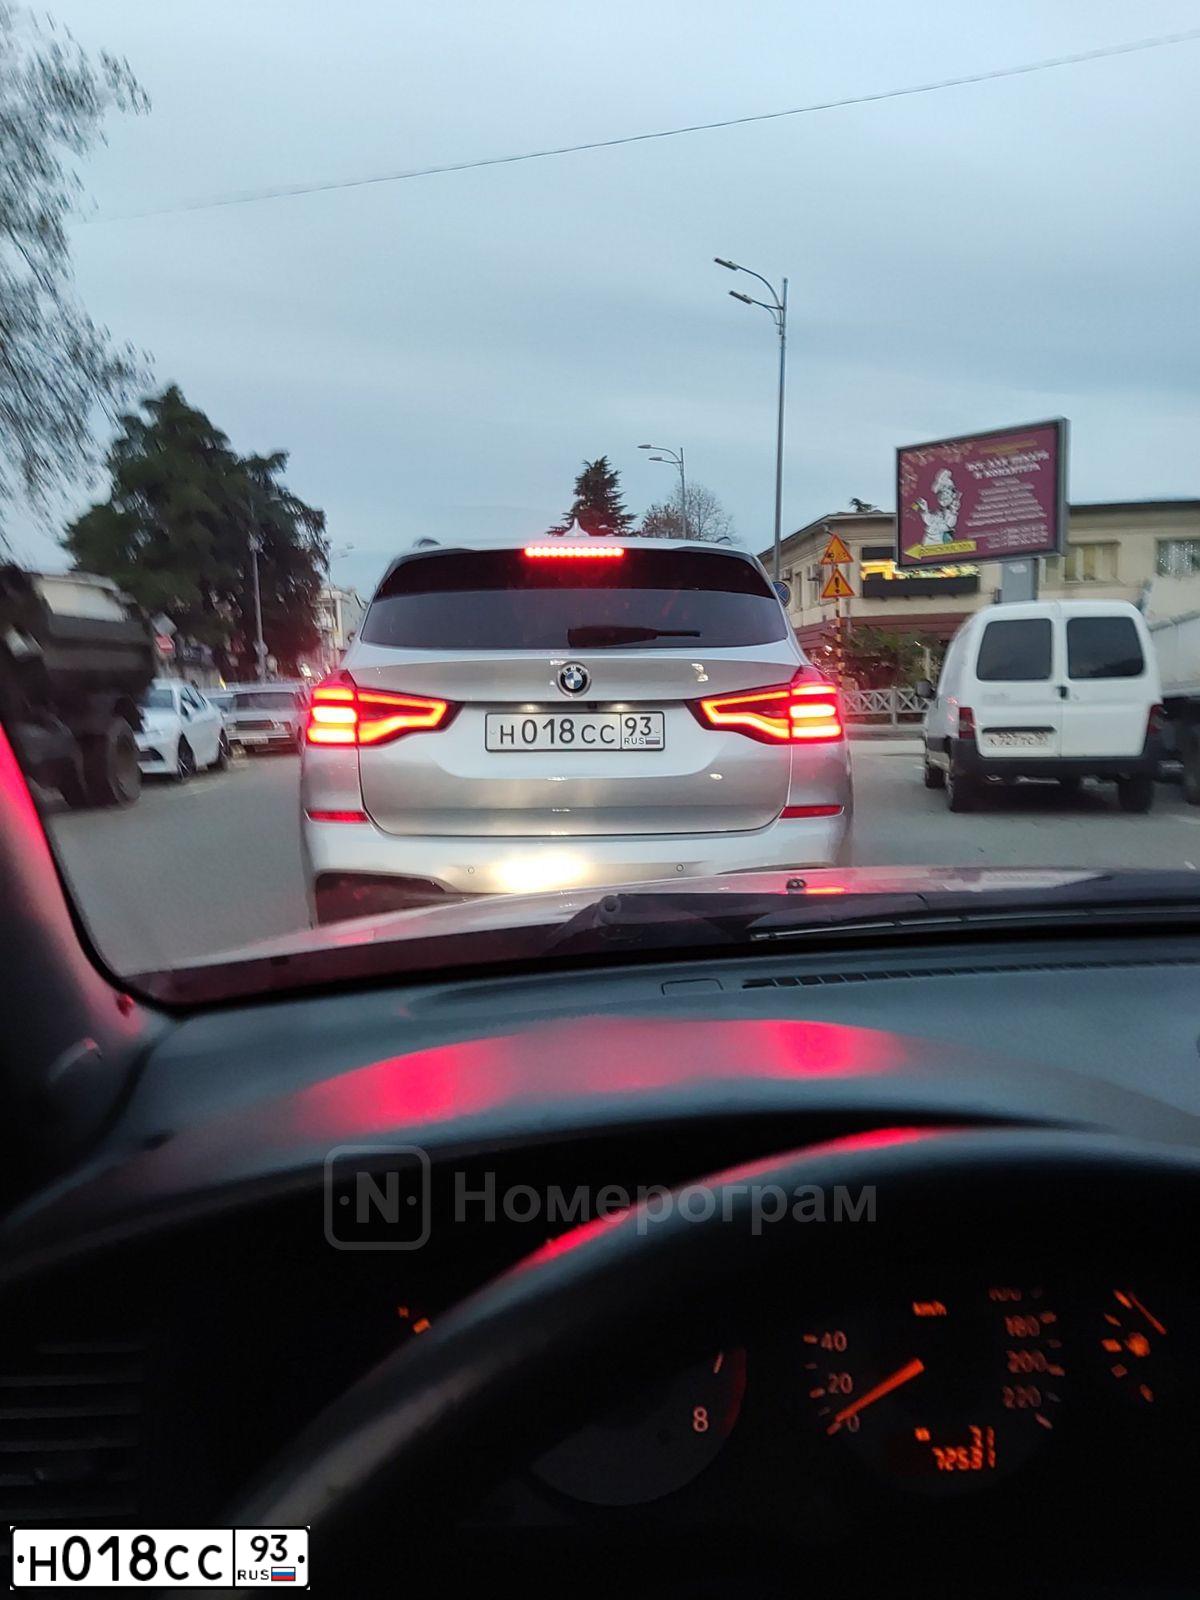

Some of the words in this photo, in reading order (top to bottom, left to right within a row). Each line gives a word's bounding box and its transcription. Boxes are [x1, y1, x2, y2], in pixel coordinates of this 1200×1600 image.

[500, 718, 615, 744] Н018СС
[624, 716, 652, 736] 93
[821, 1331, 847, 1351] 40
[828, 1373, 853, 1394] 20
[693, 1406, 709, 1432] 8
